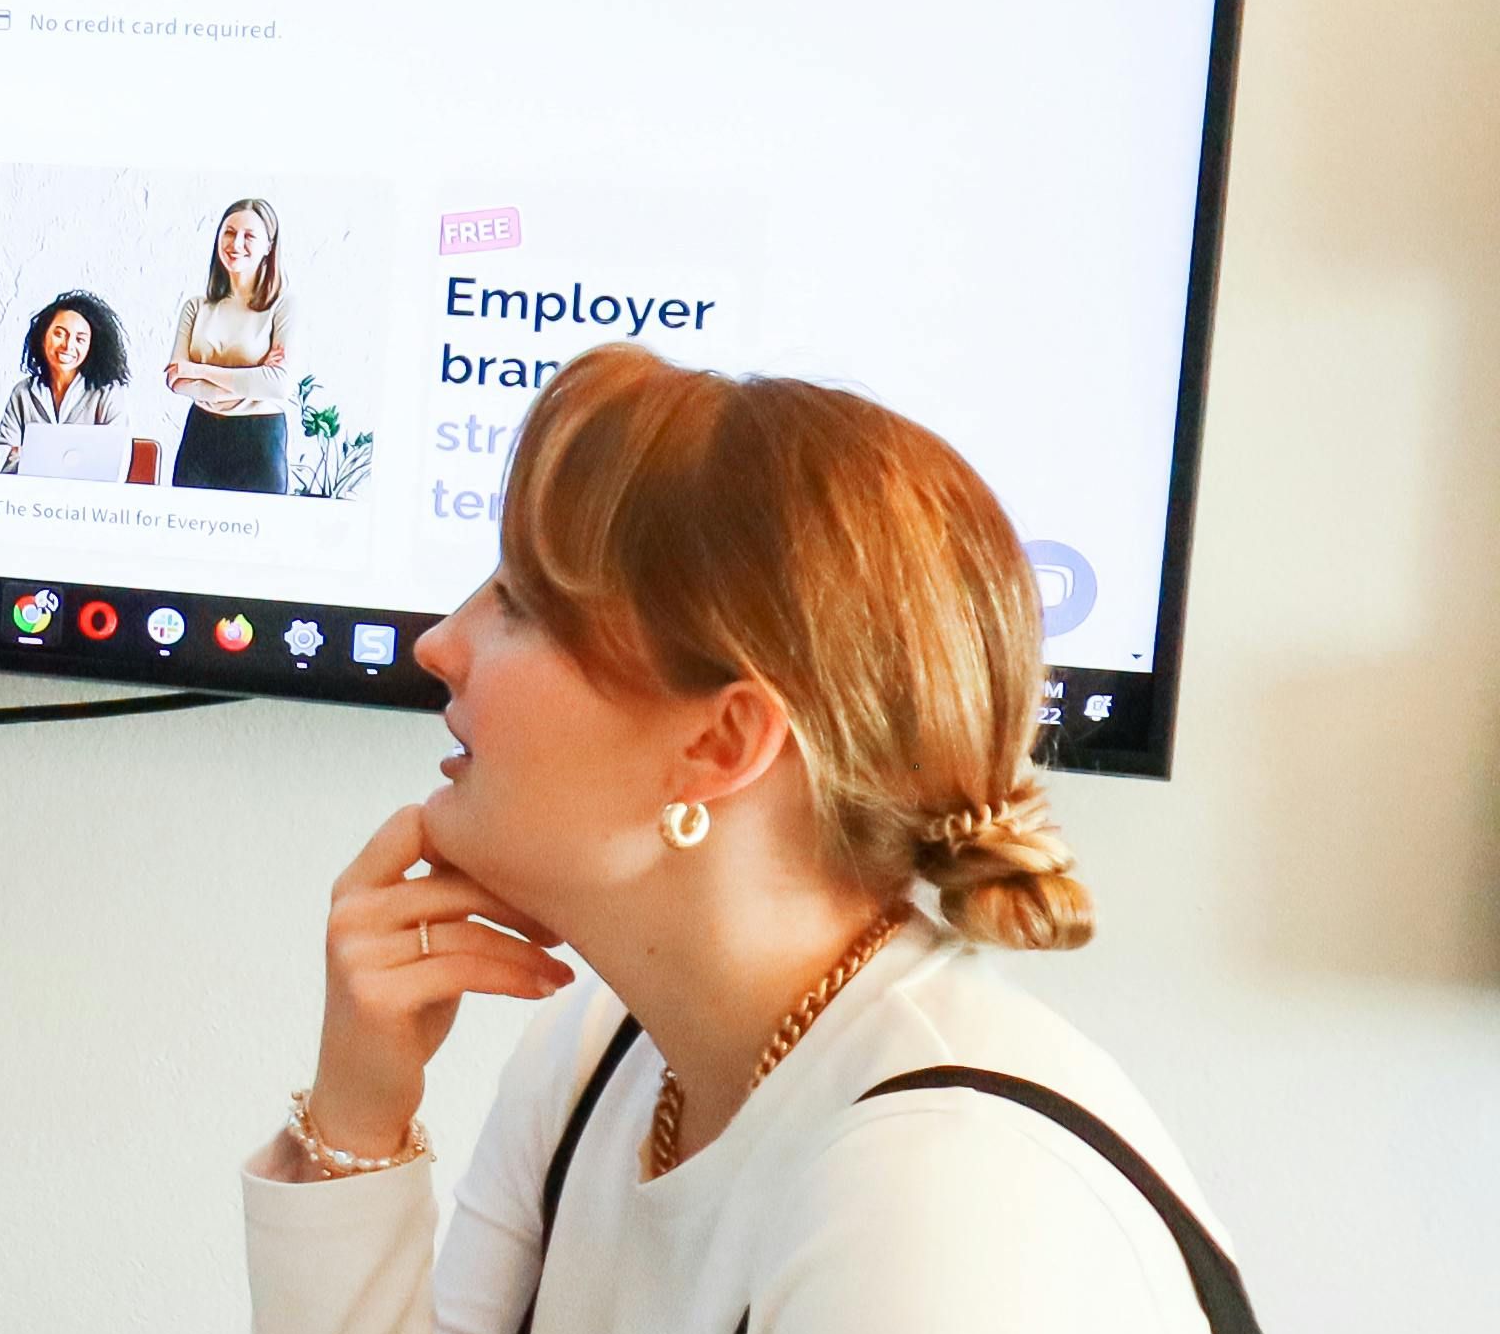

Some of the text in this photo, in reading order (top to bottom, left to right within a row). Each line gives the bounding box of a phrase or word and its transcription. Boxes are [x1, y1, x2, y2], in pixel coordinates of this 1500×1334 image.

[29, 14, 284, 42] No credit card required.
[443, 217, 511, 245] FREE
[446, 276, 716, 338] Employer
[32, 502, 87, 523] Social
[90, 507, 131, 526] Wall
[135, 510, 162, 529] for
[168, 514, 260, 539] Everyone)
